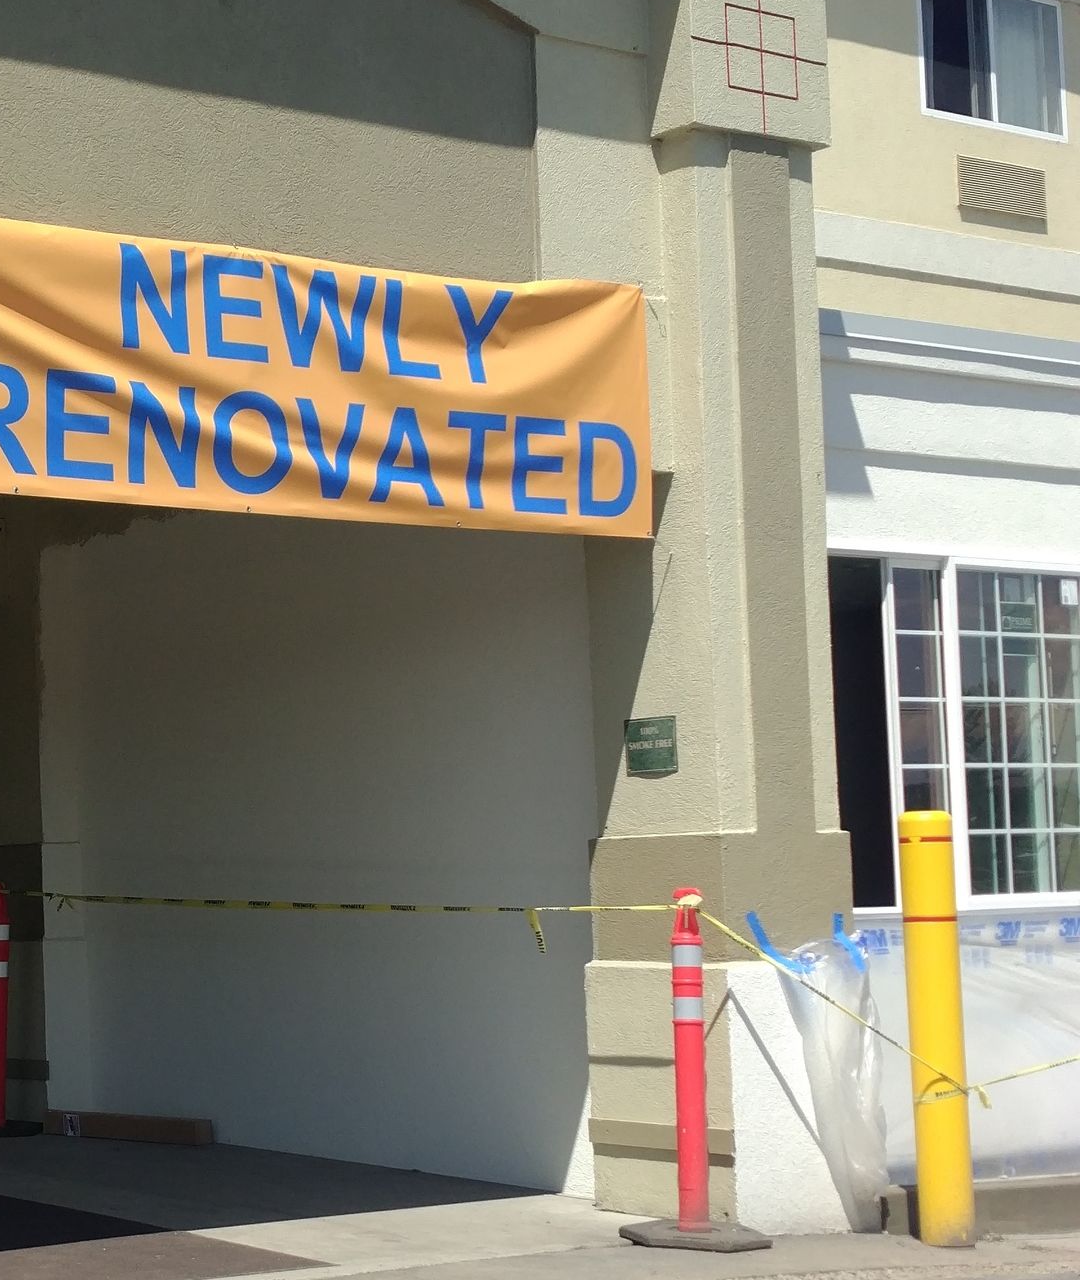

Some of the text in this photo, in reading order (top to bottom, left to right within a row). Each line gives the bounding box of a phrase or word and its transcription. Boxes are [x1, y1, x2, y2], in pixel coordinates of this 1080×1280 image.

[119, 242, 514, 384] NEWLY
[628, 738, 673, 751] SMOKE FREE
